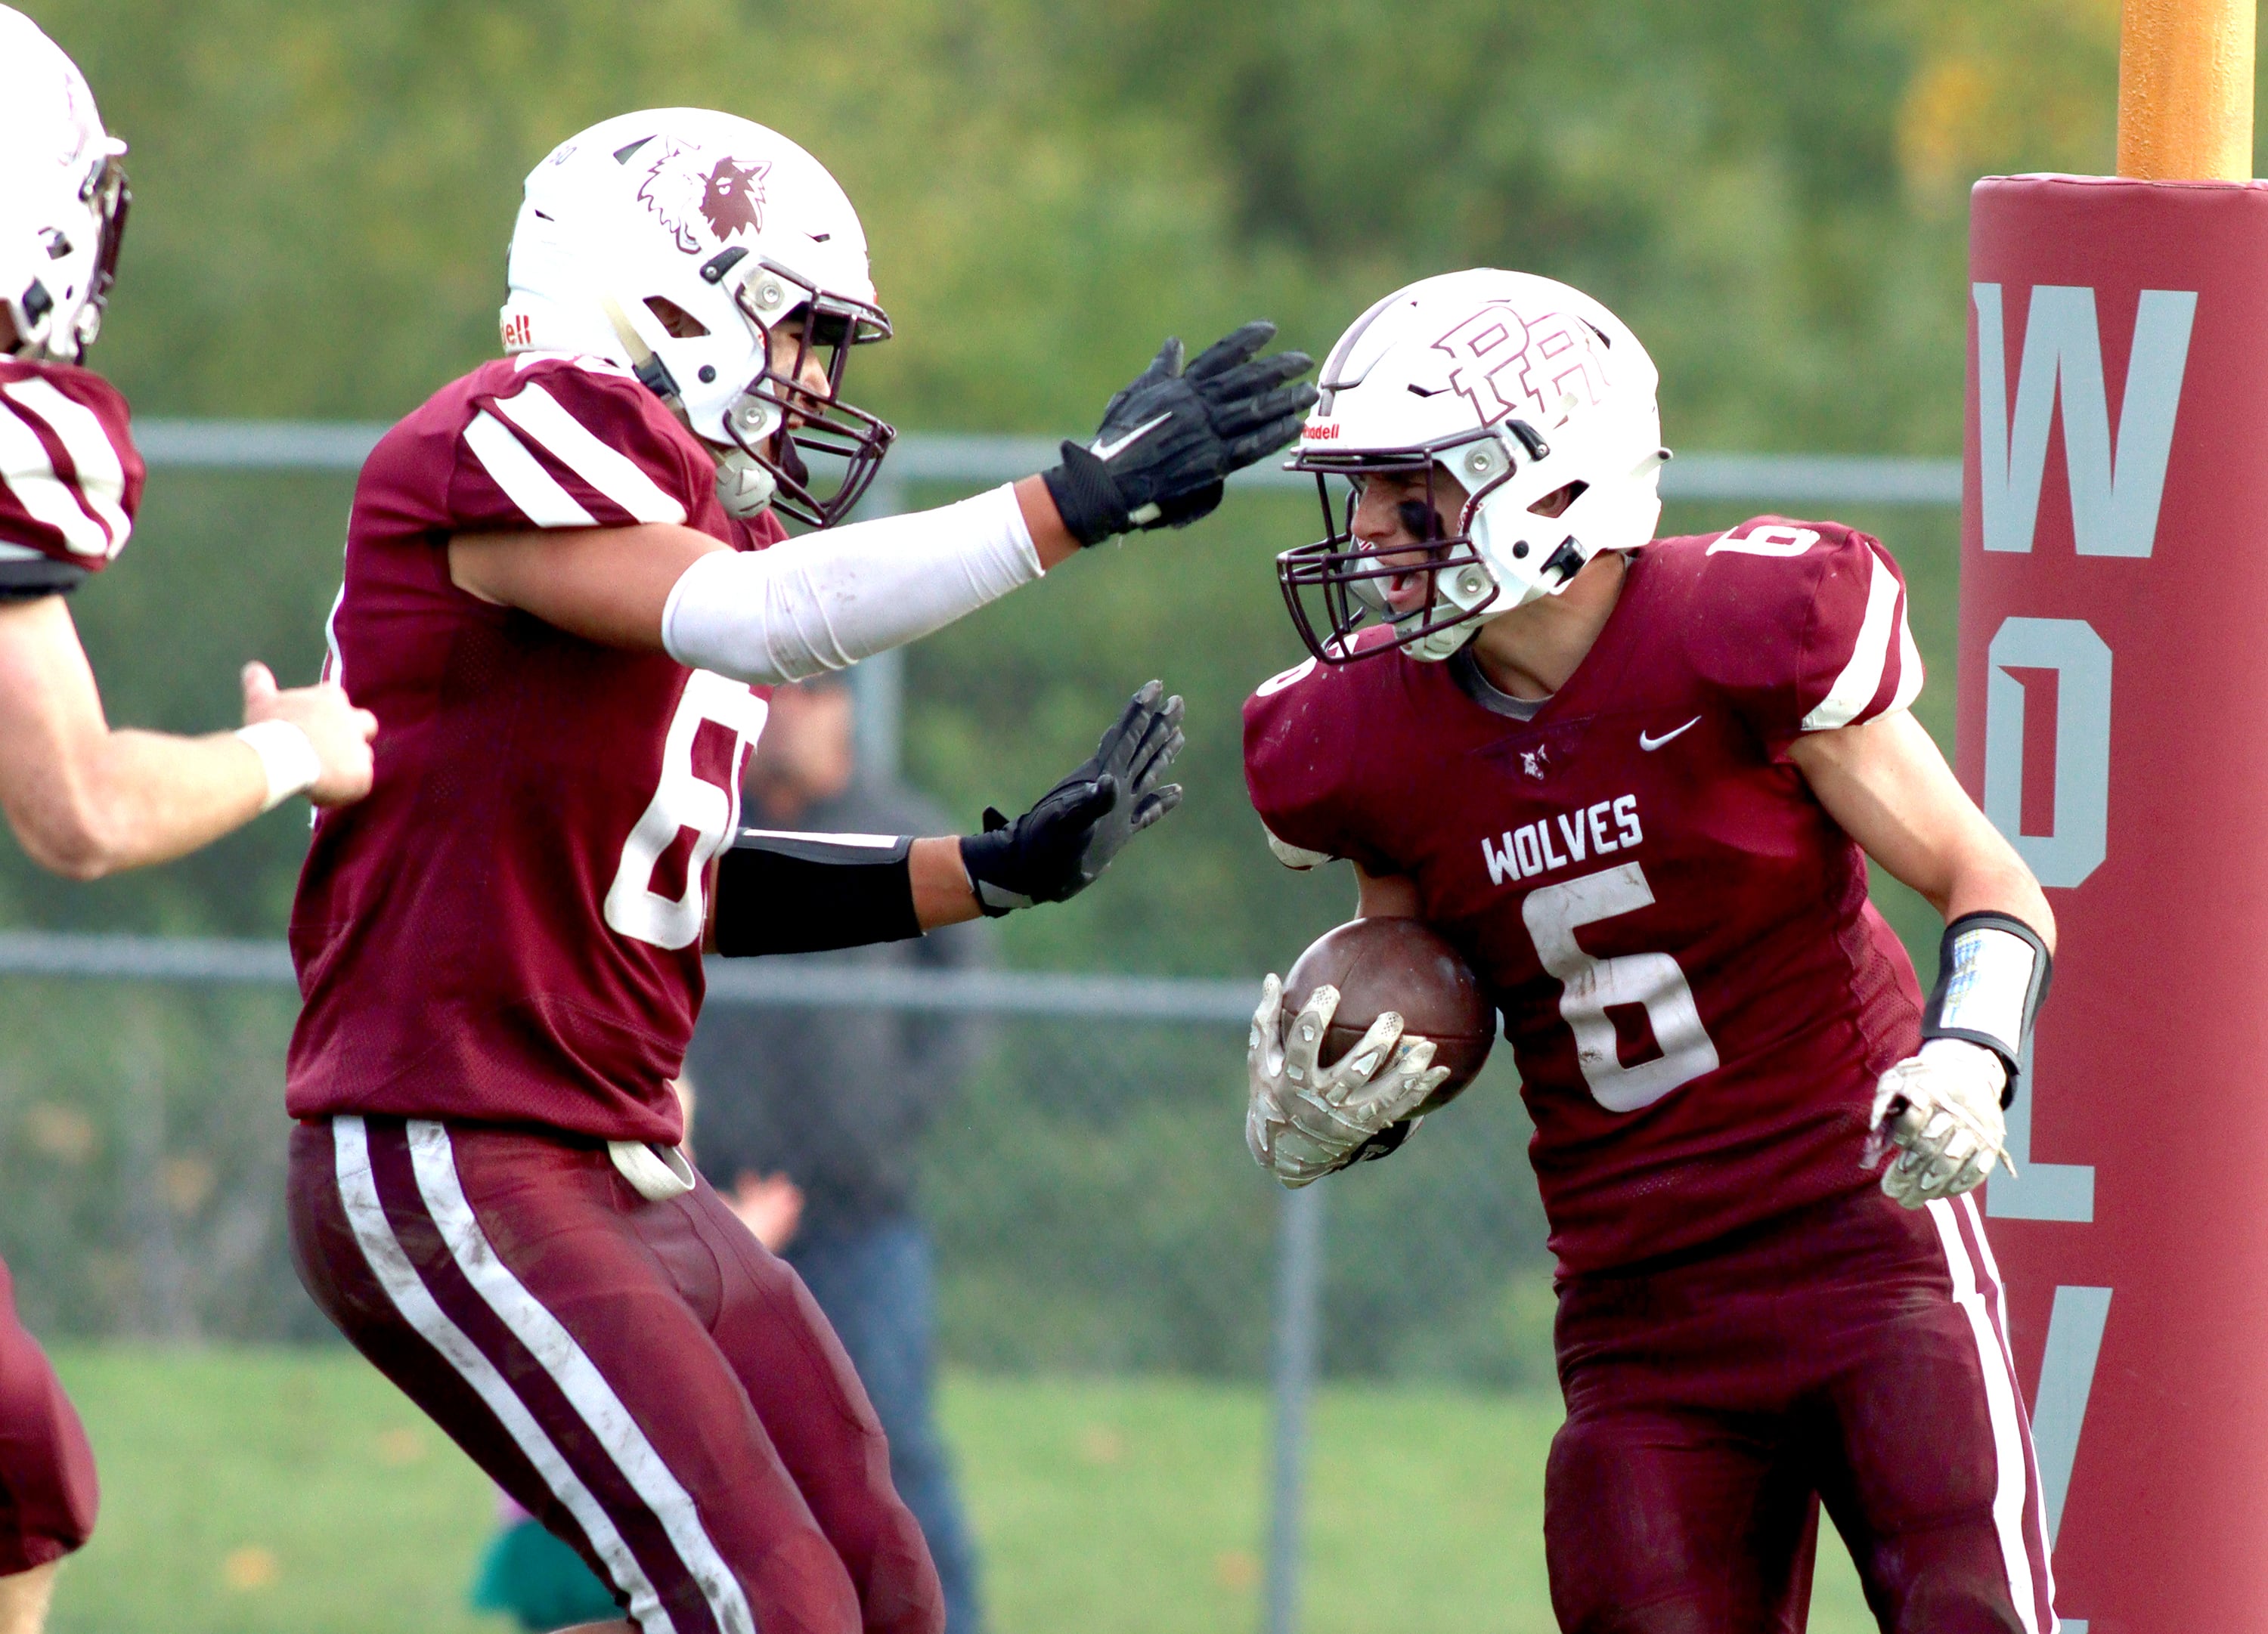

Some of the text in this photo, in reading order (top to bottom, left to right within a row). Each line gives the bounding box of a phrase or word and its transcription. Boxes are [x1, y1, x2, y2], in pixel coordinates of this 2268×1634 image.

[1706, 525, 1820, 557] 6
[603, 668, 769, 951] 6
[1481, 794, 1644, 887] WOLVES
[1521, 860, 1720, 1113] 6
